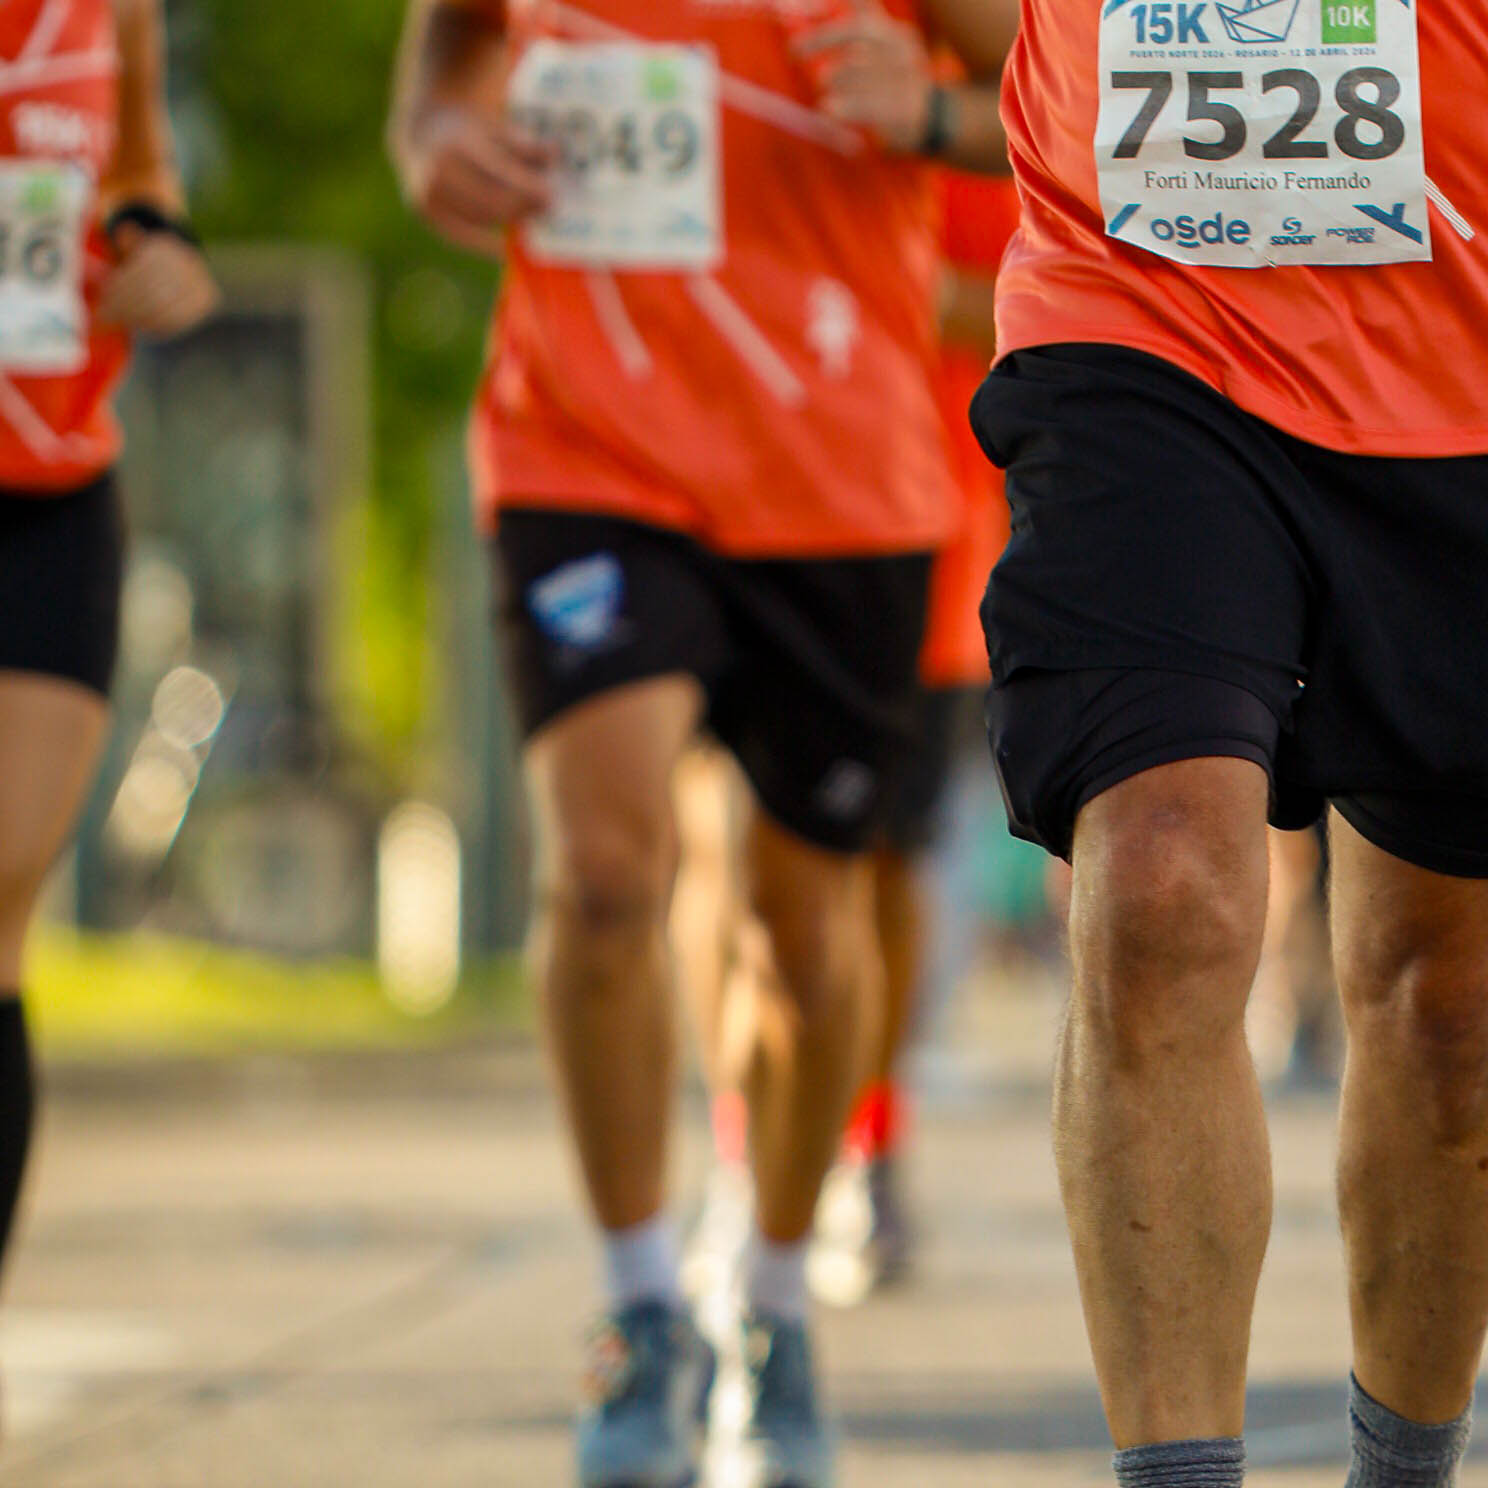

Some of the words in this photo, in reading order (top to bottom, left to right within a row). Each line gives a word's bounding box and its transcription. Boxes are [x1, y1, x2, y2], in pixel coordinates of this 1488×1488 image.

[1130, 3, 1211, 44] 15K
[1326, 6, 1371, 28] 10K
[1129, 49, 1165, 58] PUERTO
[1169, 49, 1198, 58] NORTE
[1235, 49, 1279, 57] ROSARIO
[1304, 48, 1317, 56] DE
[1319, 47, 1348, 56] ABRIL
[1111, 67, 1405, 161] 7528
[1144, 171, 1188, 189] Forti
[1193, 172, 1278, 190] Mauricio
[1283, 171, 1371, 190] Fernando
[1150, 211, 1251, 248] osde
